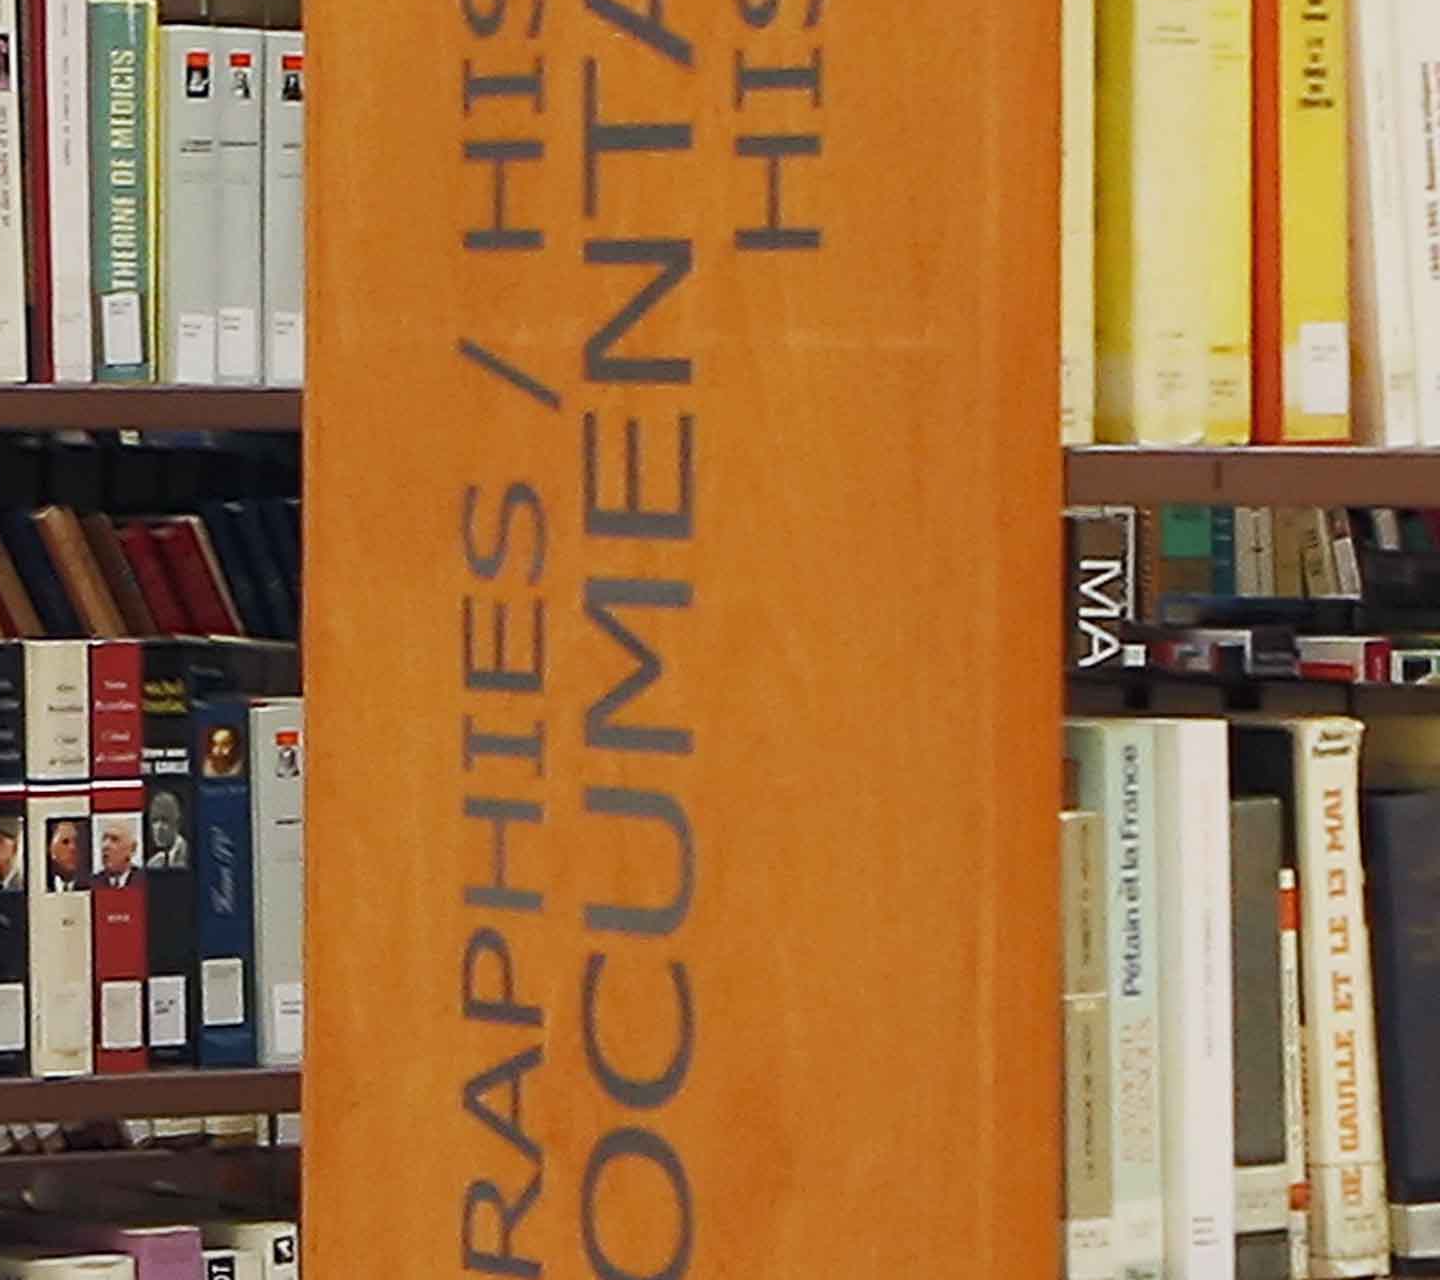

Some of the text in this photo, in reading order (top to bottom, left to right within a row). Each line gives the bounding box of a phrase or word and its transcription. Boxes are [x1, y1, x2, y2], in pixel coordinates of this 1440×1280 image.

[109, 158, 136, 186] DE
[108, 196, 140, 289] THERINE
[456, 336, 564, 411] /
[1120, 744, 1139, 842] France
[1323, 788, 1345, 853] MAI
[1328, 916, 1350, 956] LE
